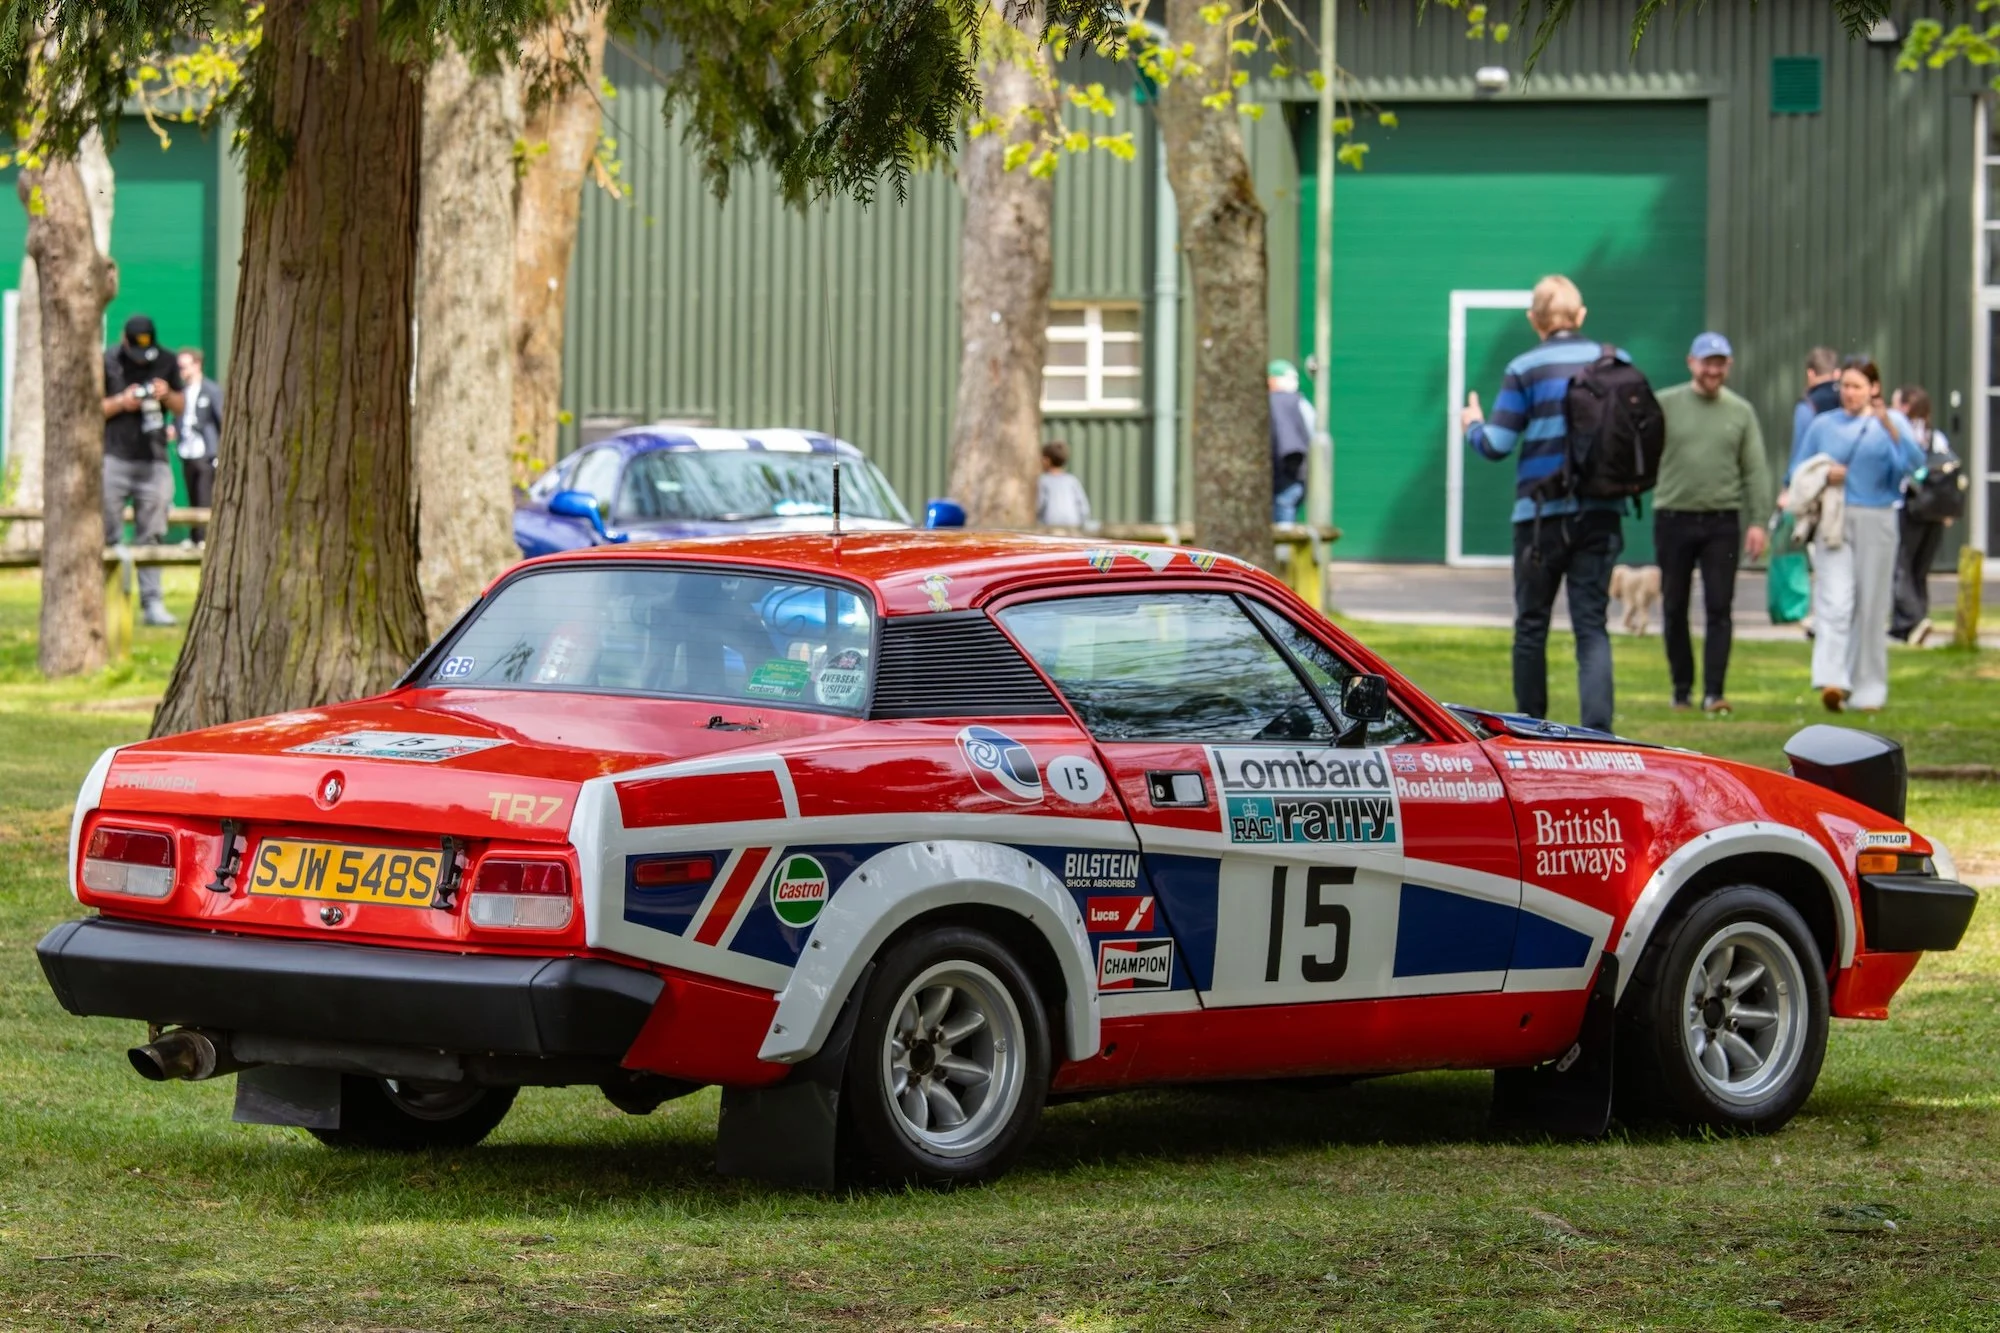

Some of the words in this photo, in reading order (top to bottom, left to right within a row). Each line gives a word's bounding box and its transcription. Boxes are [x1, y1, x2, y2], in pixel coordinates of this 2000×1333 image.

[440, 657, 473, 676] GB
[386, 736, 437, 748] 15
[1212, 750, 1390, 790] Lombard
[1420, 752, 1474, 773] Steve
[1528, 751, 1568, 770] SIMO
[1570, 751, 1646, 771] LAMPINEN
[117, 772, 198, 791] TRIUMPH
[1063, 767, 1089, 790] 15
[1396, 776, 1505, 802] Rockingham
[487, 791, 563, 825] TR7
[1232, 816, 1275, 841] RAC
[1276, 796, 1390, 842] rally
[1532, 808, 1624, 846] British
[1868, 834, 1907, 844] DUNLOP
[256, 844, 330, 892] SJW
[335, 850, 437, 900] 548S
[1064, 853, 1140, 879] BILSTEIN
[1535, 846, 1627, 881] airways
[778, 880, 825, 900] Castrol
[1066, 878, 1092, 888] SHOCK
[1093, 878, 1137, 888] ABSORBERS
[1090, 907, 1120, 922] Lucas
[1264, 866, 1358, 982] 15
[1104, 955, 1167, 975] CHAMPION
